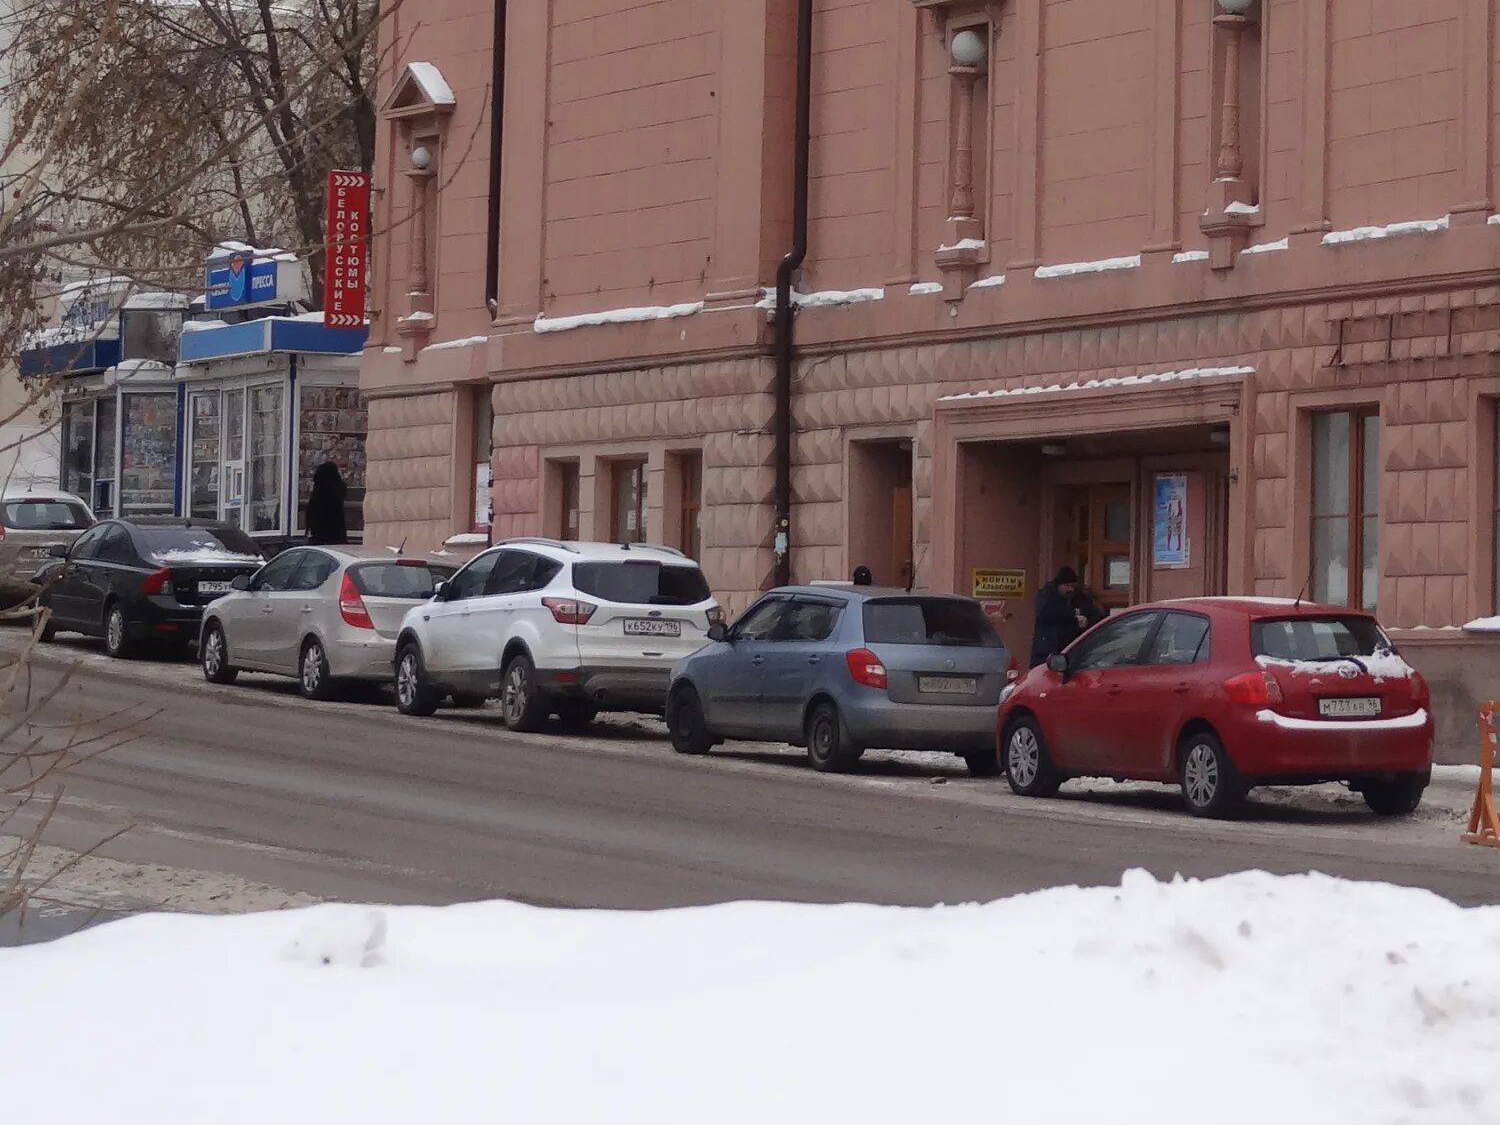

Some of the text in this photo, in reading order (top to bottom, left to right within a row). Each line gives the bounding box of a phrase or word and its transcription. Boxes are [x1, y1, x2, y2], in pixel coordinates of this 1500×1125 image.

[252, 274, 274, 290] ПРЕССА
[334, 188, 346, 311] БЕЛОРУССКИЕ
[347, 211, 360, 289] КОСТЮМЫ
